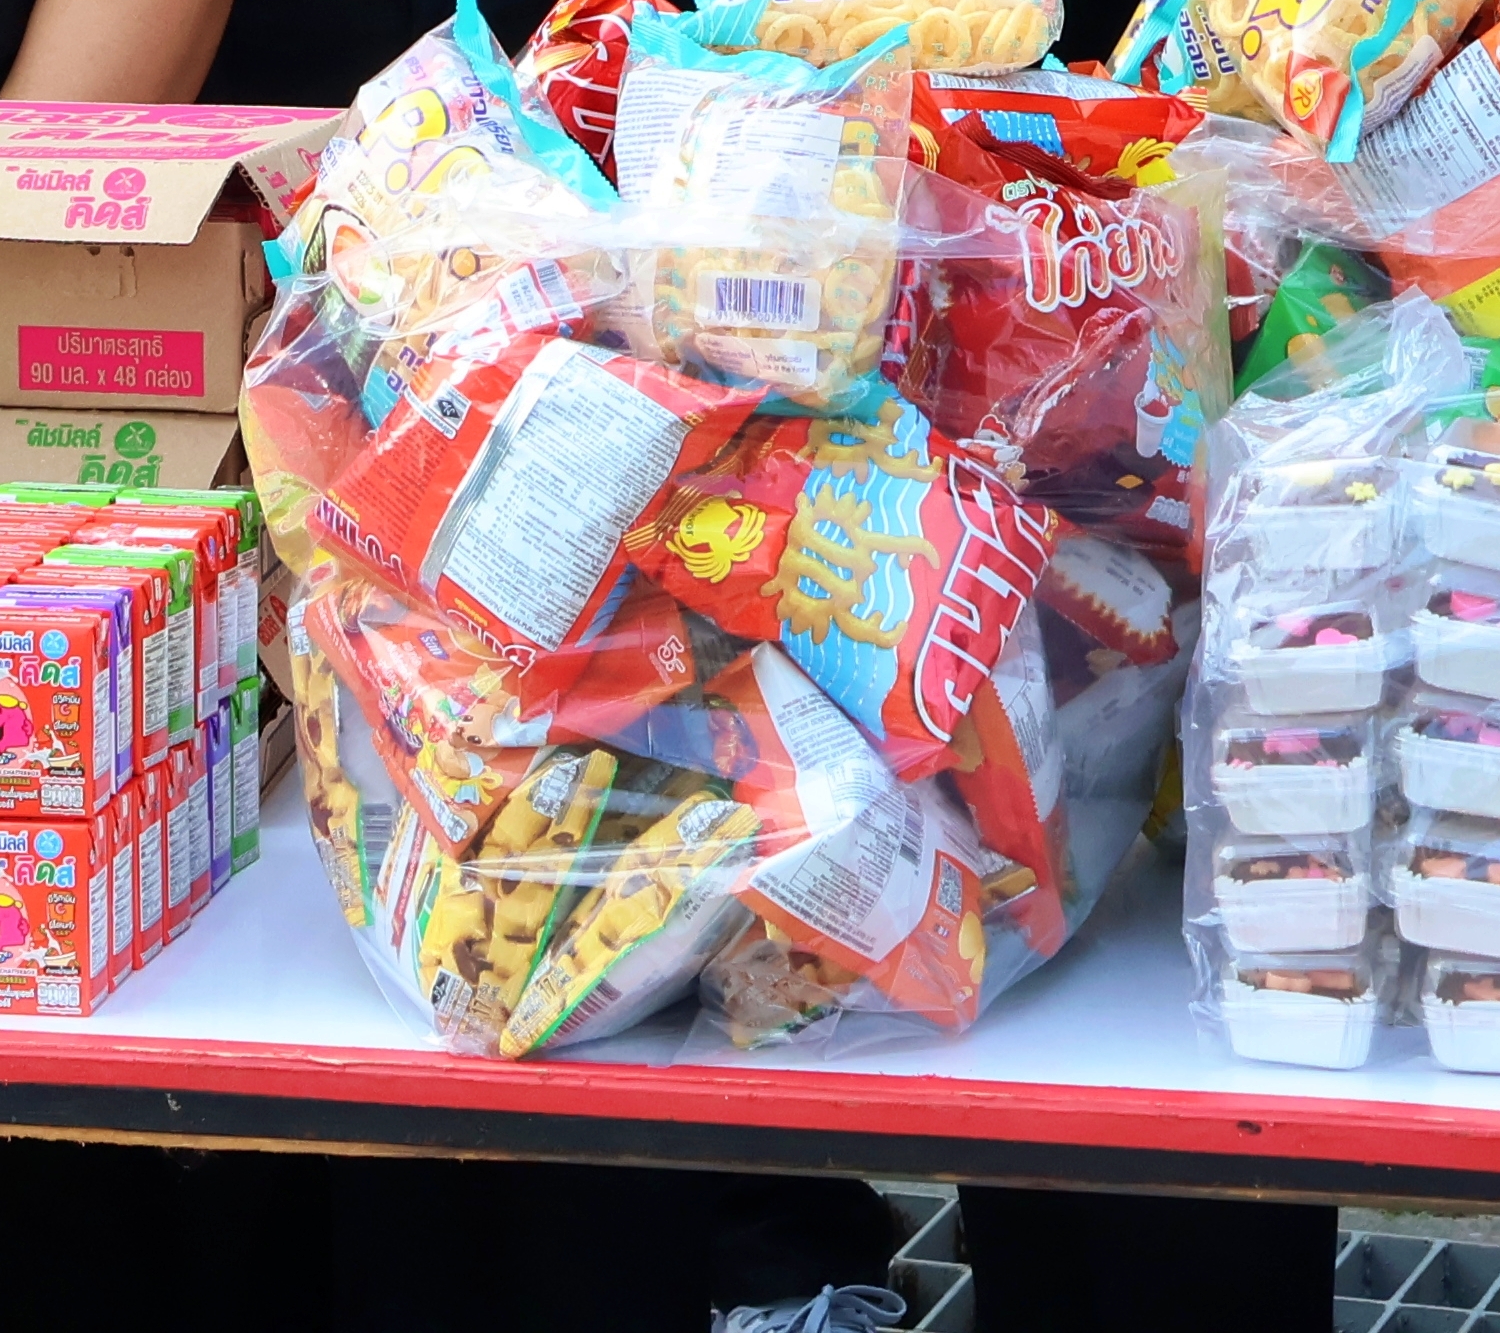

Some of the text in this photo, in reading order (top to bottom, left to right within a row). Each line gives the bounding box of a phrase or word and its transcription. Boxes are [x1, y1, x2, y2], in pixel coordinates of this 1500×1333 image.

[1179, 8, 1211, 81] อร่อย
[16, 168, 93, 194] ดัชมิลล์
[65, 195, 153, 229] คิดส์
[57, 333, 164, 365] ปริมาตรสุทธิ
[30, 362, 192, 390] 90 มล. x 48 กล่อง
[26, 422, 102, 448] ดัชมิลล์
[19, 657, 80, 687] คิดส์
[14, 857, 75, 886] คิดส์
